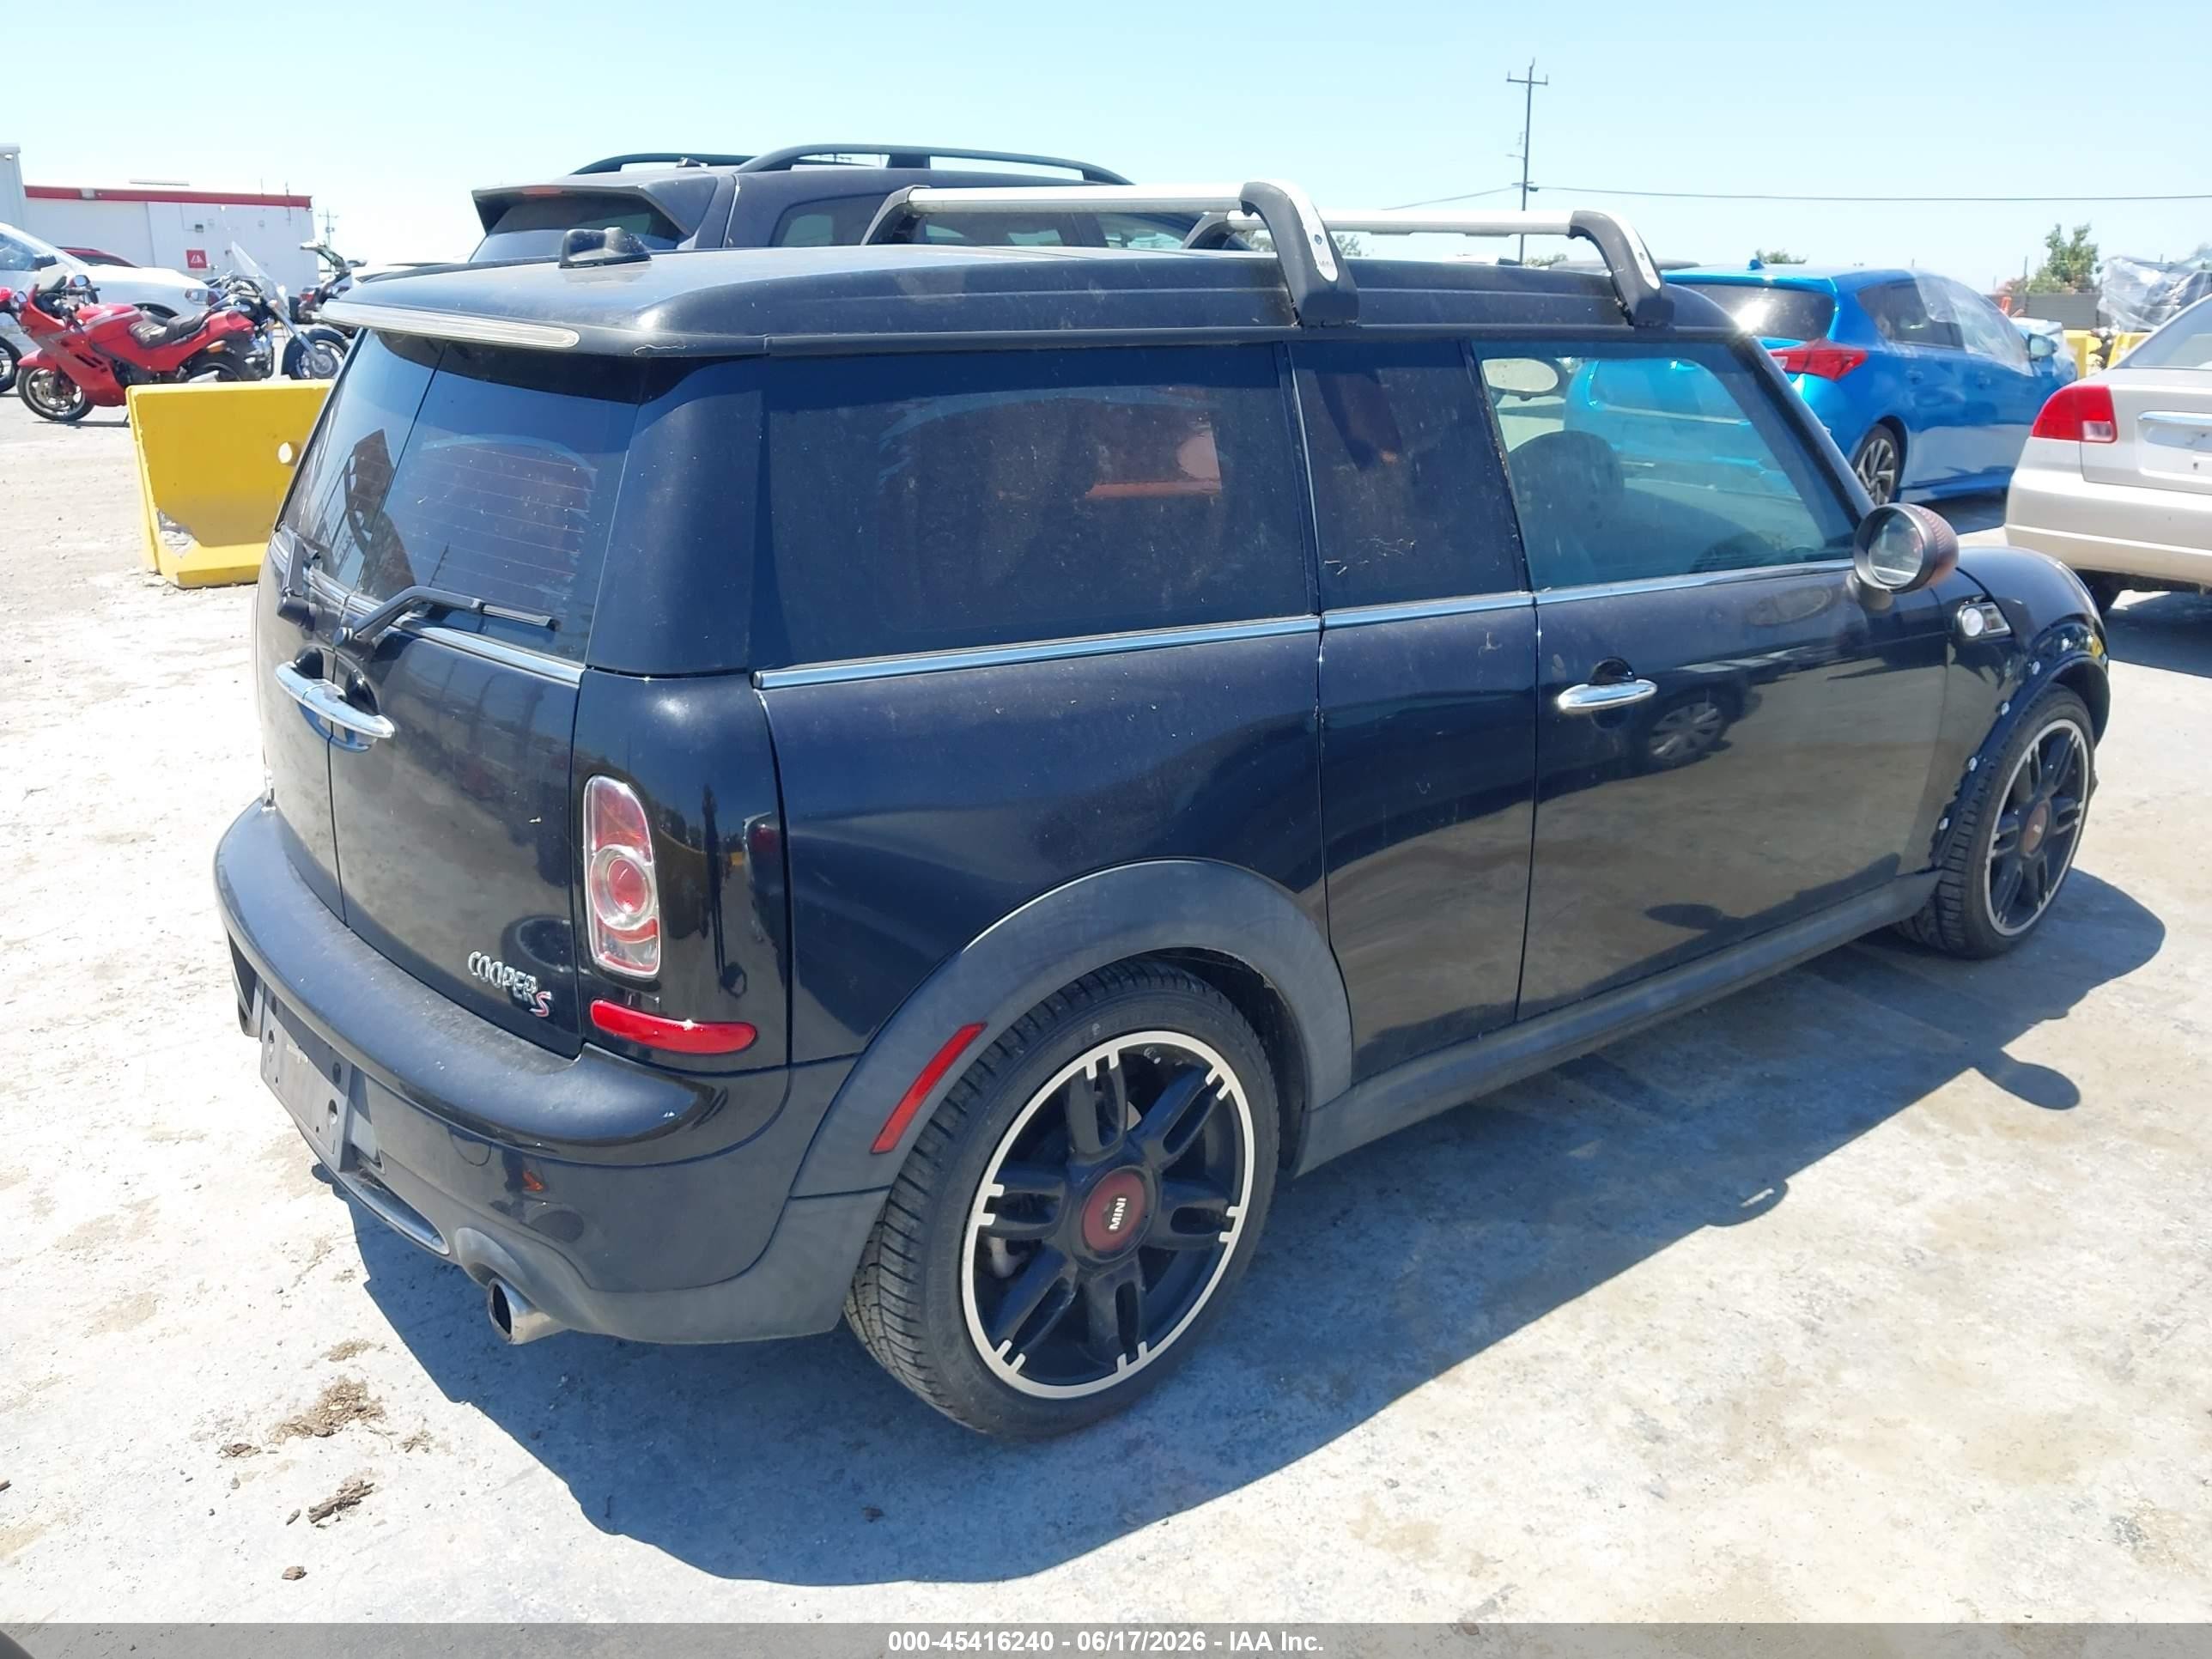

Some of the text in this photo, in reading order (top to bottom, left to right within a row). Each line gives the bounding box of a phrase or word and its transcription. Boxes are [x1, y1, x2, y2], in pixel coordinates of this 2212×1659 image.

[468, 951, 552, 1018] COOPER S
[1109, 1197, 1127, 1231] MINI
